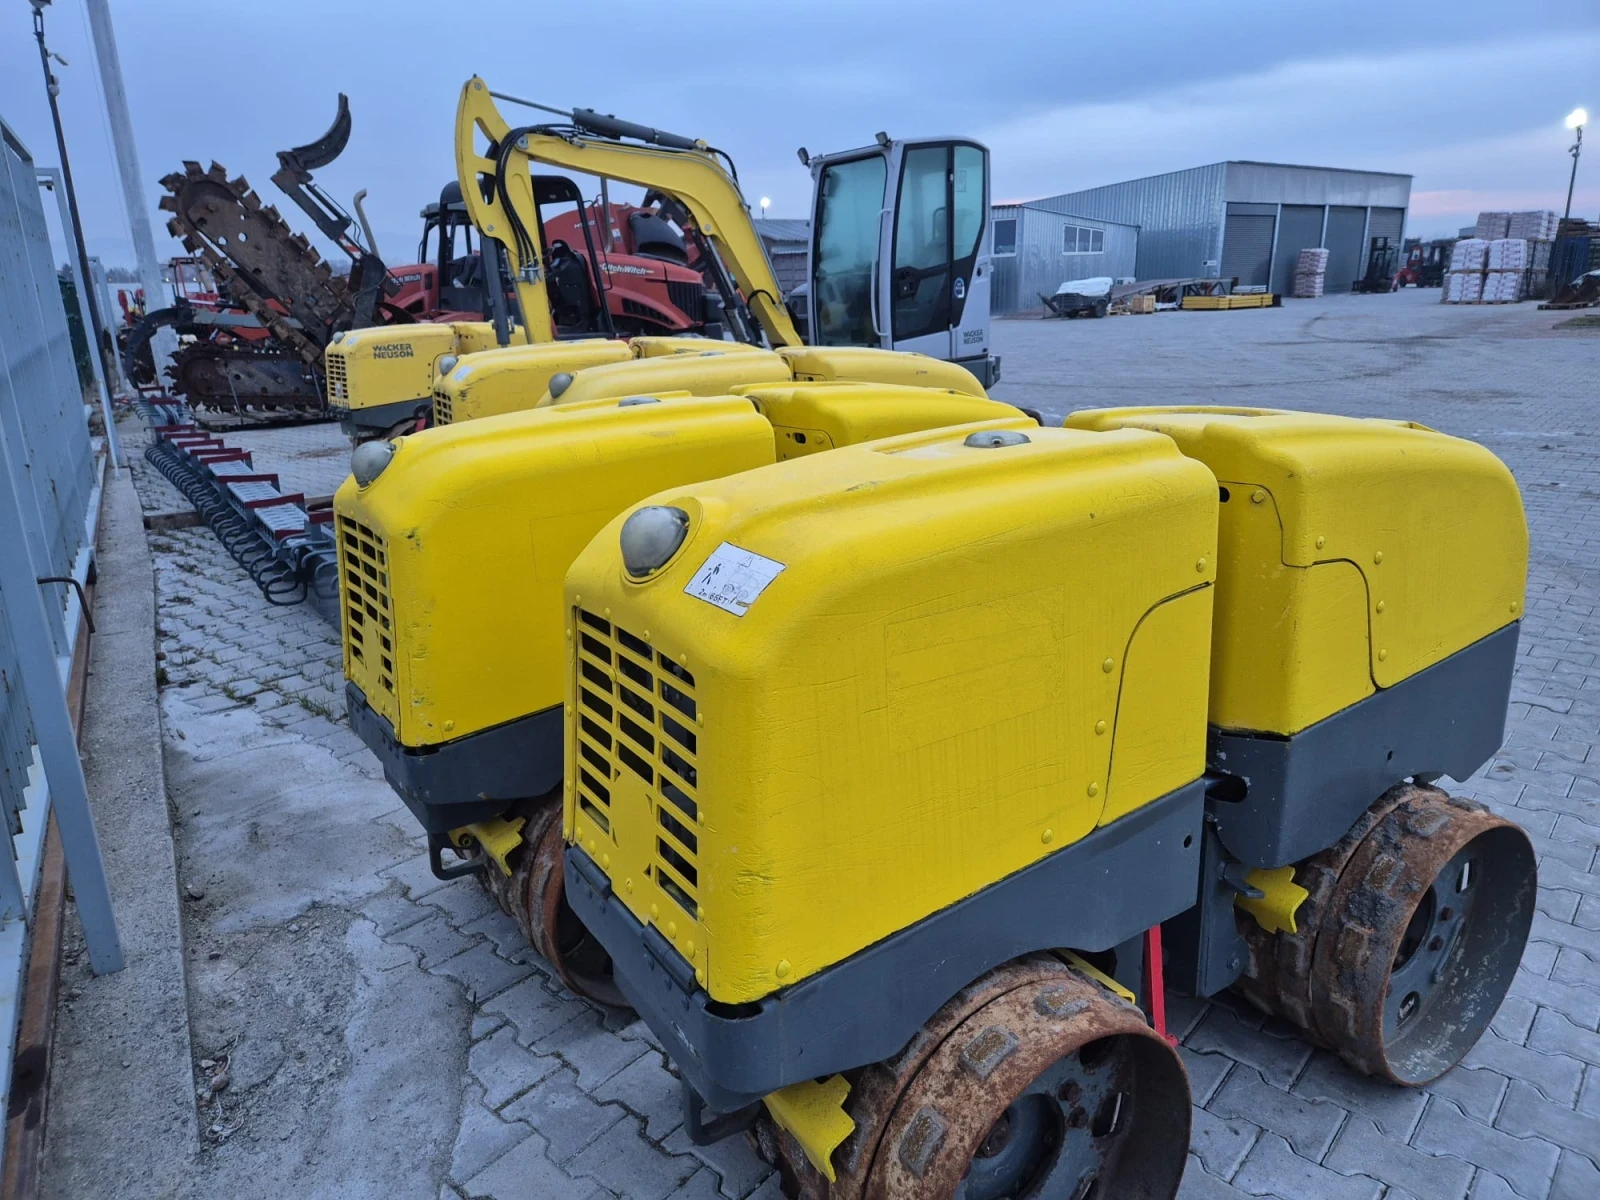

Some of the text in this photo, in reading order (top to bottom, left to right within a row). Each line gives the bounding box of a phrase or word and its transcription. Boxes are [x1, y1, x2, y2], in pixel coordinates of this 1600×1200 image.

[624, 265, 646, 275] Witch
[372, 343, 412, 351] WACKER
[373, 350, 414, 359] NEUSON
